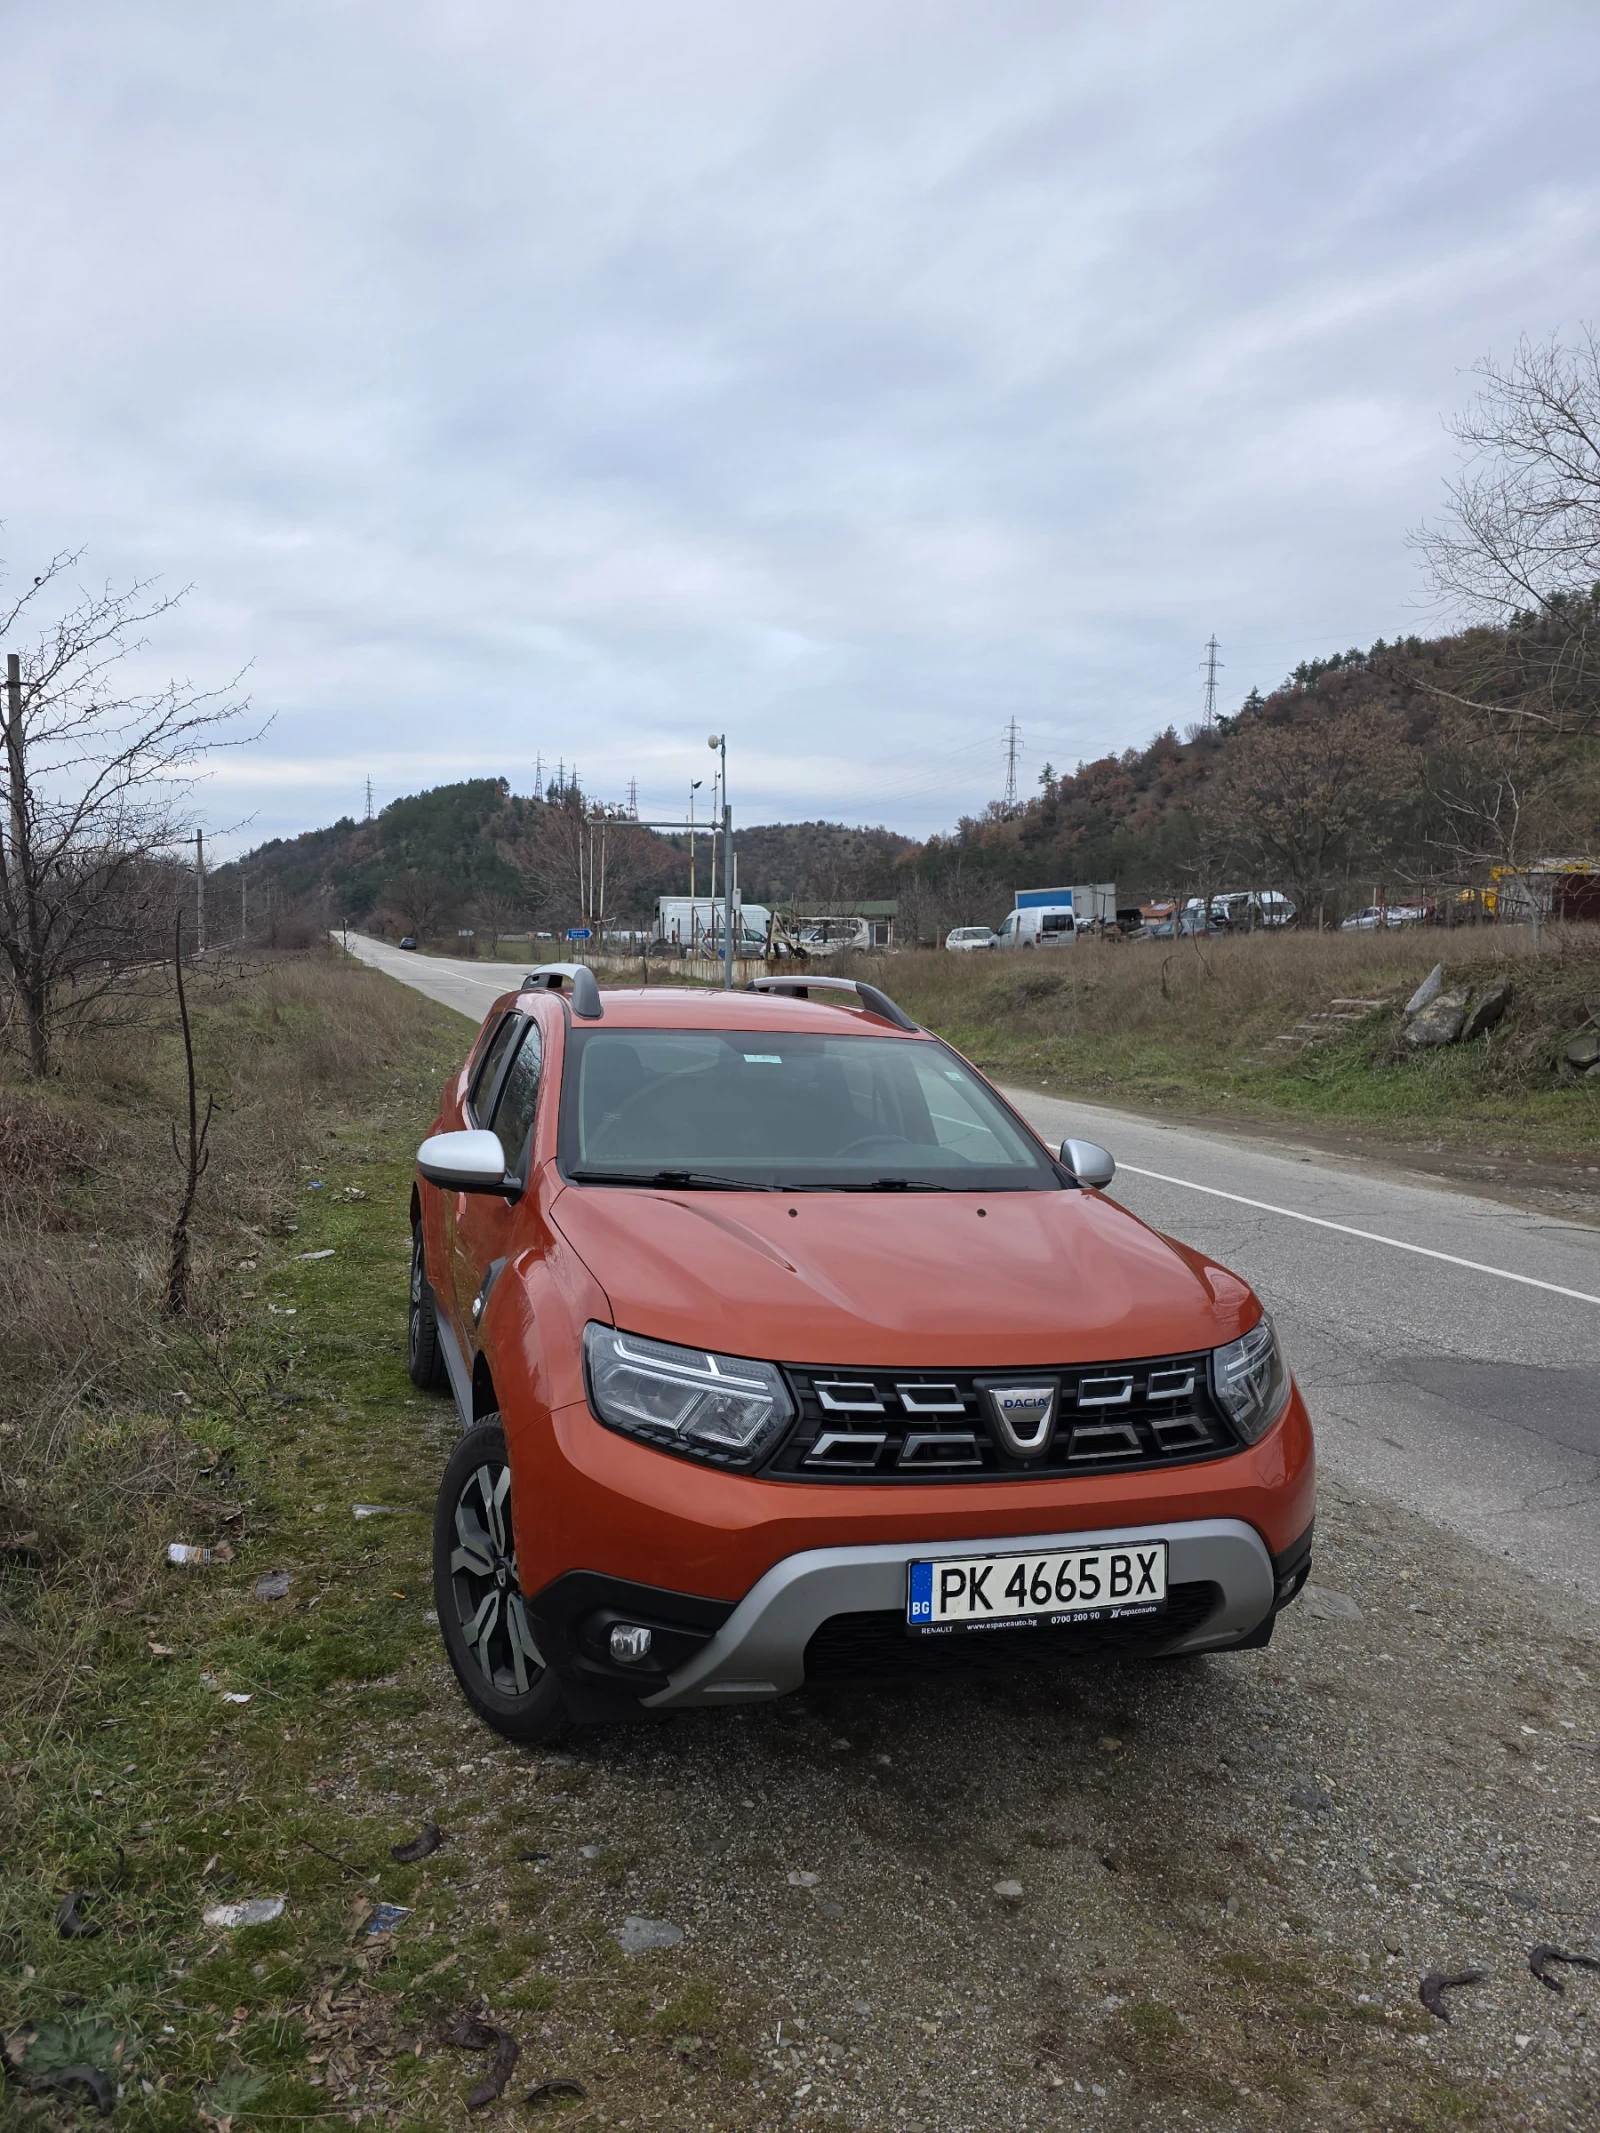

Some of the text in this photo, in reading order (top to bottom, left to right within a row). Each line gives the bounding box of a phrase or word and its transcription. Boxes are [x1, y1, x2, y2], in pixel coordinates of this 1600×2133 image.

[1004, 1398, 1046, 1408] DACIA
[940, 1551, 1158, 1614] PK 4665 BX
[912, 1602, 929, 1615] BG
[1120, 1606, 1157, 1617] espaceauto
[1051, 1612, 1100, 1624] 0700 200 90
[921, 1626, 953, 1634] RENAULT
[967, 1619, 1037, 1630] www.espaceauto.bg
